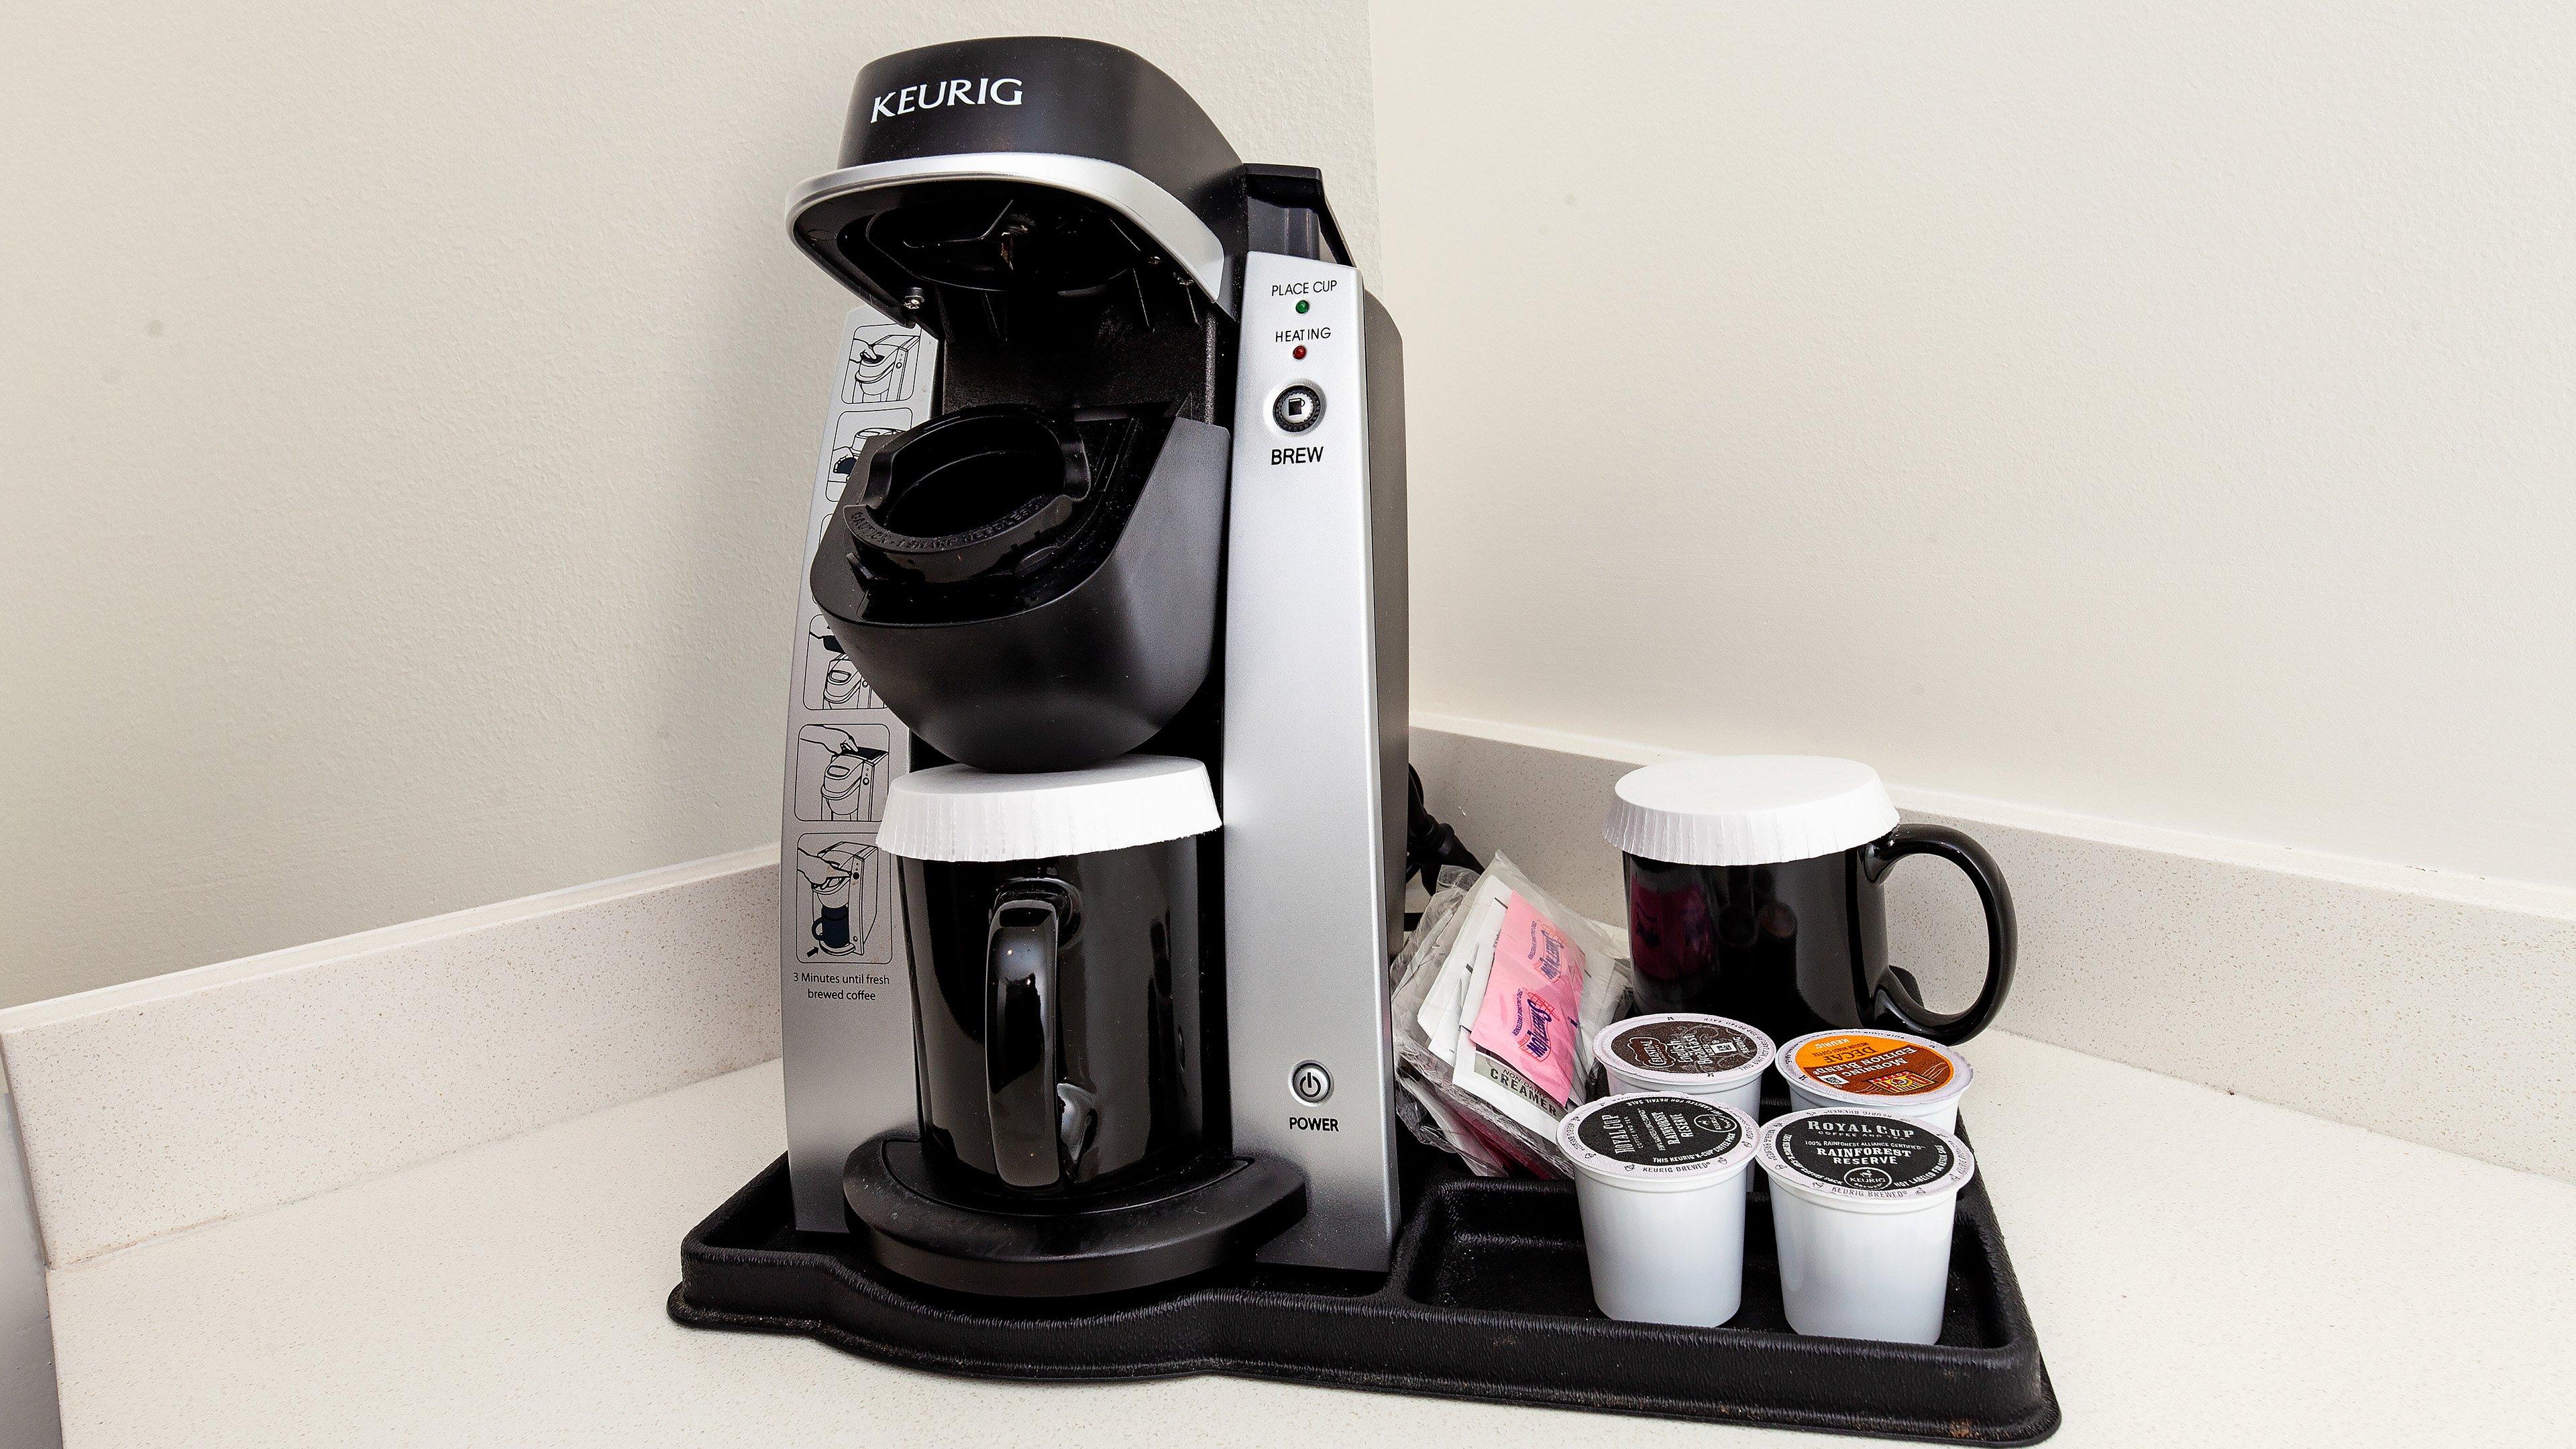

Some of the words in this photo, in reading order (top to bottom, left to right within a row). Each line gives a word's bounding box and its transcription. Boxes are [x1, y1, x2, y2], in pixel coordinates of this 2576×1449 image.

[870, 78, 1024, 123] KEURIG
[1271, 282, 1309, 297] PLACE
[1313, 280, 1338, 294] CUP
[1275, 326, 1332, 343] HEATING
[1271, 446, 1324, 466] BREW
[793, 973, 799, 982] 3
[801, 973, 839, 983] Minutes
[842, 973, 864, 984] until
[866, 974, 890, 985] fresh
[808, 988, 844, 1000] brewed
[846, 990, 876, 1001] coffee
[1666, 1040, 1694, 1063] English
[1682, 1034, 1713, 1065] Breakfast
[1815, 1038, 1850, 1049] KEURIG
[1823, 1046, 1878, 1063] DECAF
[1860, 1047, 1917, 1065] EDITION
[1841, 1057, 1909, 1077] MORNING
[1490, 1068, 1557, 1117] CREAMER
[1503, 1069, 1549, 1099] NON-DAIRY
[1289, 1117, 1339, 1132] POWER
[1602, 1115, 1623, 1129] CUP
[1807, 1120, 1872, 1133] ROYAL
[1876, 1125, 1915, 1138] CUP
[1609, 1129, 1635, 1154] ROYAL
[1817, 1147, 1912, 1158] RAINFOREST
[1833, 1157, 1898, 1165] RESERVE
[1831, 1186, 1864, 1196] KEURIG
